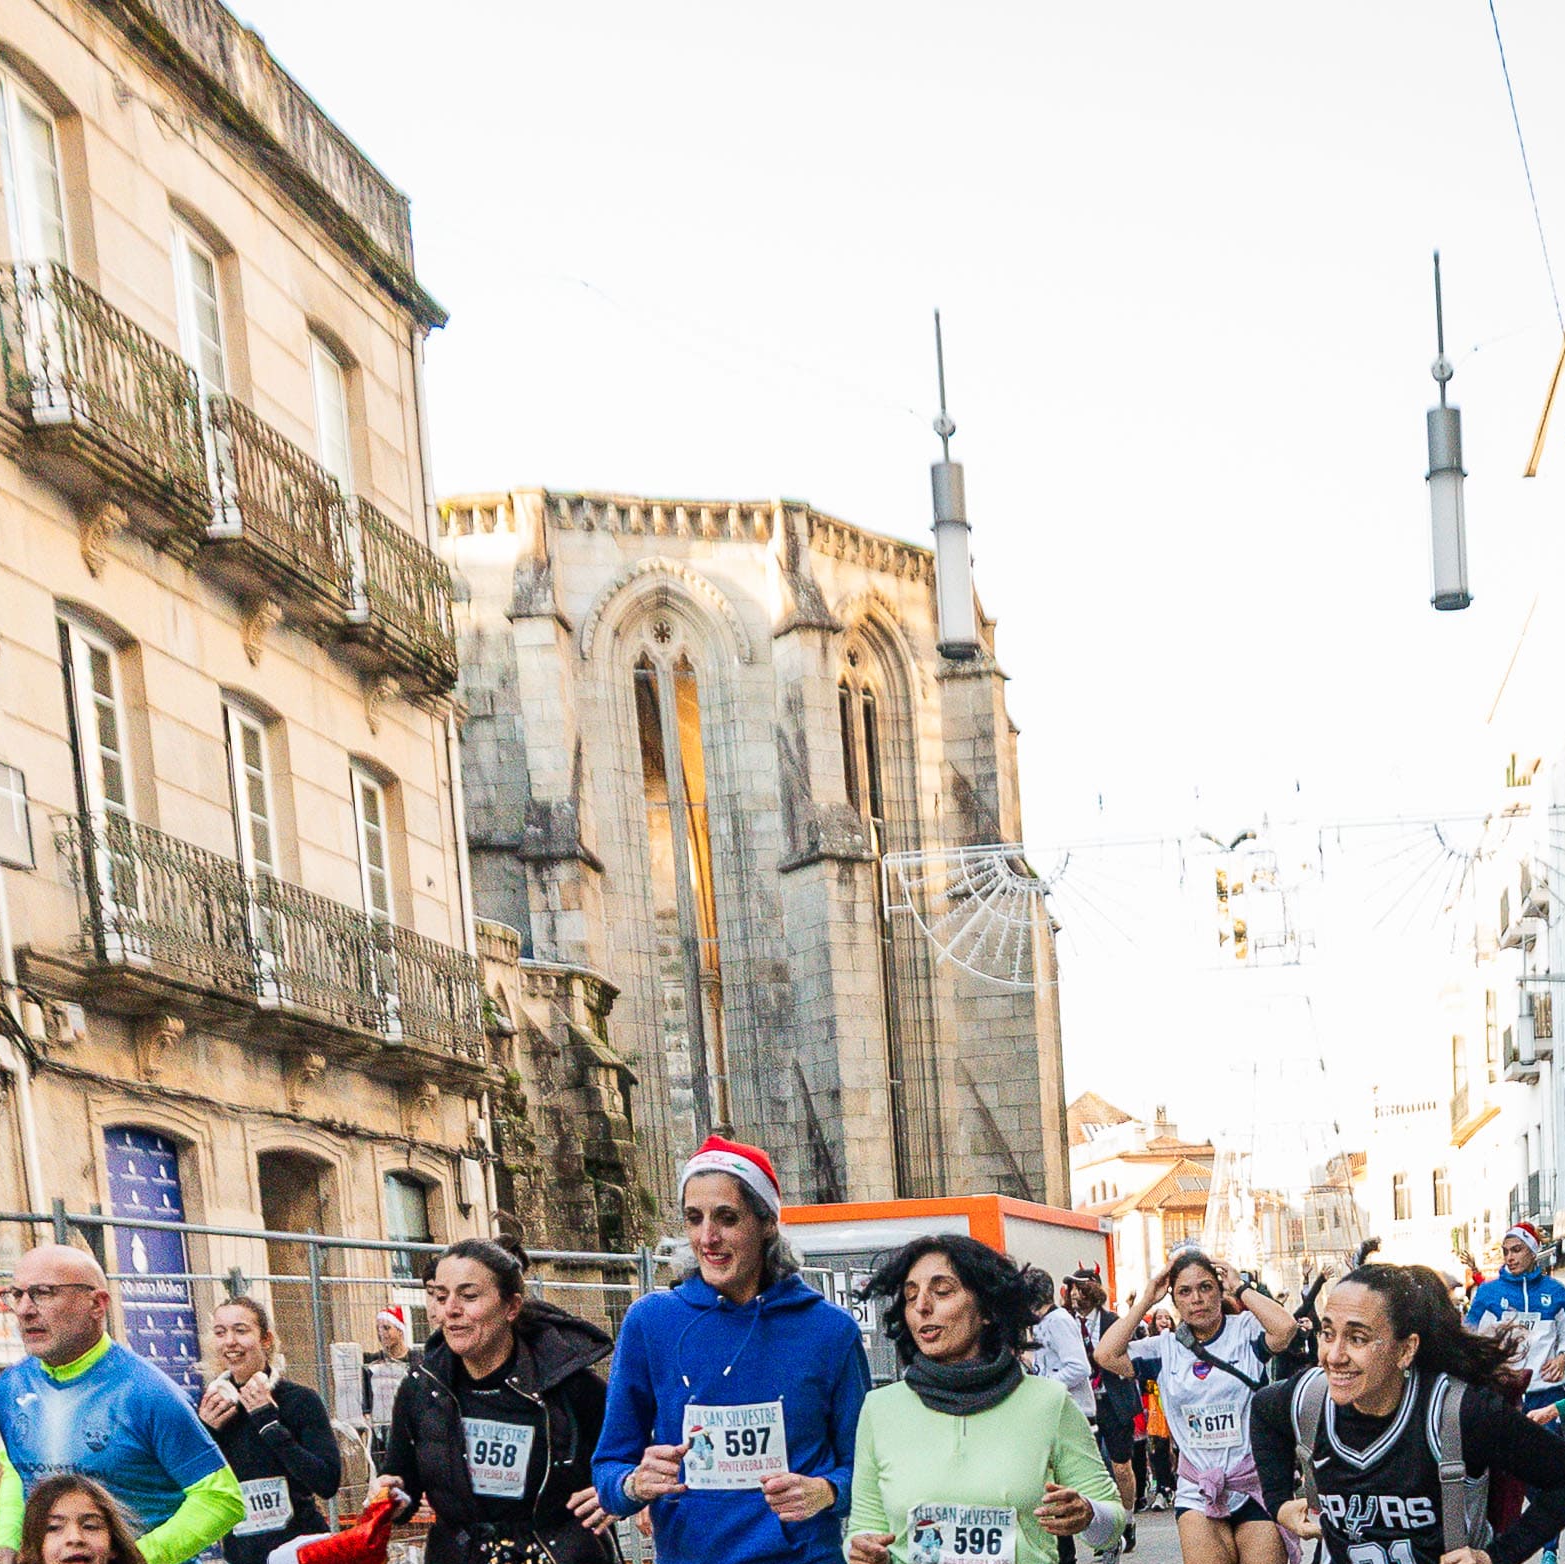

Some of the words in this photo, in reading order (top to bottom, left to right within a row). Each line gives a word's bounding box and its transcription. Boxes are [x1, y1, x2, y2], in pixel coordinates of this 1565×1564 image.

[703, 1409, 724, 1427] SAN
[726, 1406, 778, 1428] SILVESTRE
[1205, 1413, 1235, 1432] 6171
[481, 1423, 529, 1443] SILVESTRE
[724, 1426, 771, 1458] 597
[473, 1439, 518, 1468] 958
[717, 1459, 763, 1473] PONTEVEDRA
[765, 1456, 782, 1470] 2025
[248, 1490, 281, 1512] 1187
[935, 1506, 957, 1524] SAN
[959, 1508, 1012, 1527] SILVESTRE
[953, 1526, 1003, 1556] 596
